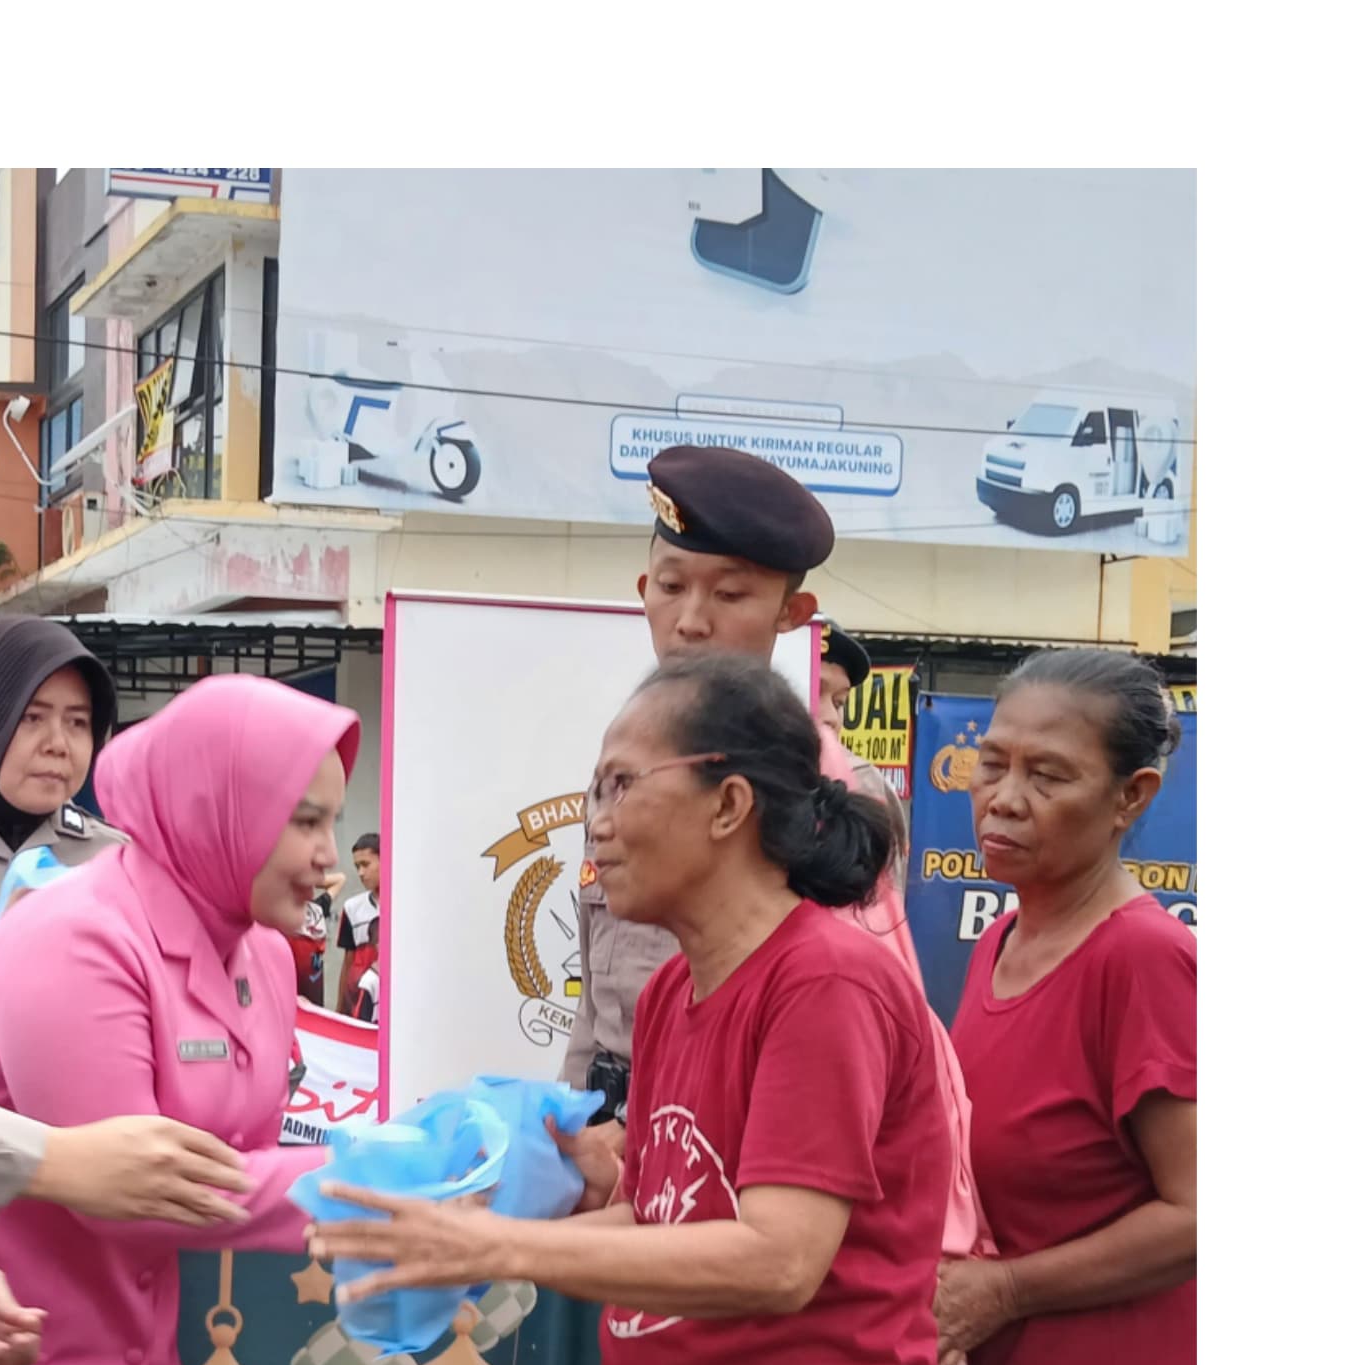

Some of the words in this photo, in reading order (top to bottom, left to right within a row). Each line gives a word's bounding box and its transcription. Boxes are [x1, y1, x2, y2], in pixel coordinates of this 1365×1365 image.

[619, 445, 654, 458] DARI
[632, 428, 693, 445] KHUSUS
[696, 432, 748, 449] UNTUK
[751, 436, 816, 453] KIRIMAN
[817, 441, 883, 457] REGULAR
[843, 673, 907, 730] UAL
[867, 737, 886, 760] 100
[527, 798, 584, 832] BHAY
[925, 852, 984, 879] POL
[537, 1004, 573, 1029] KEM
